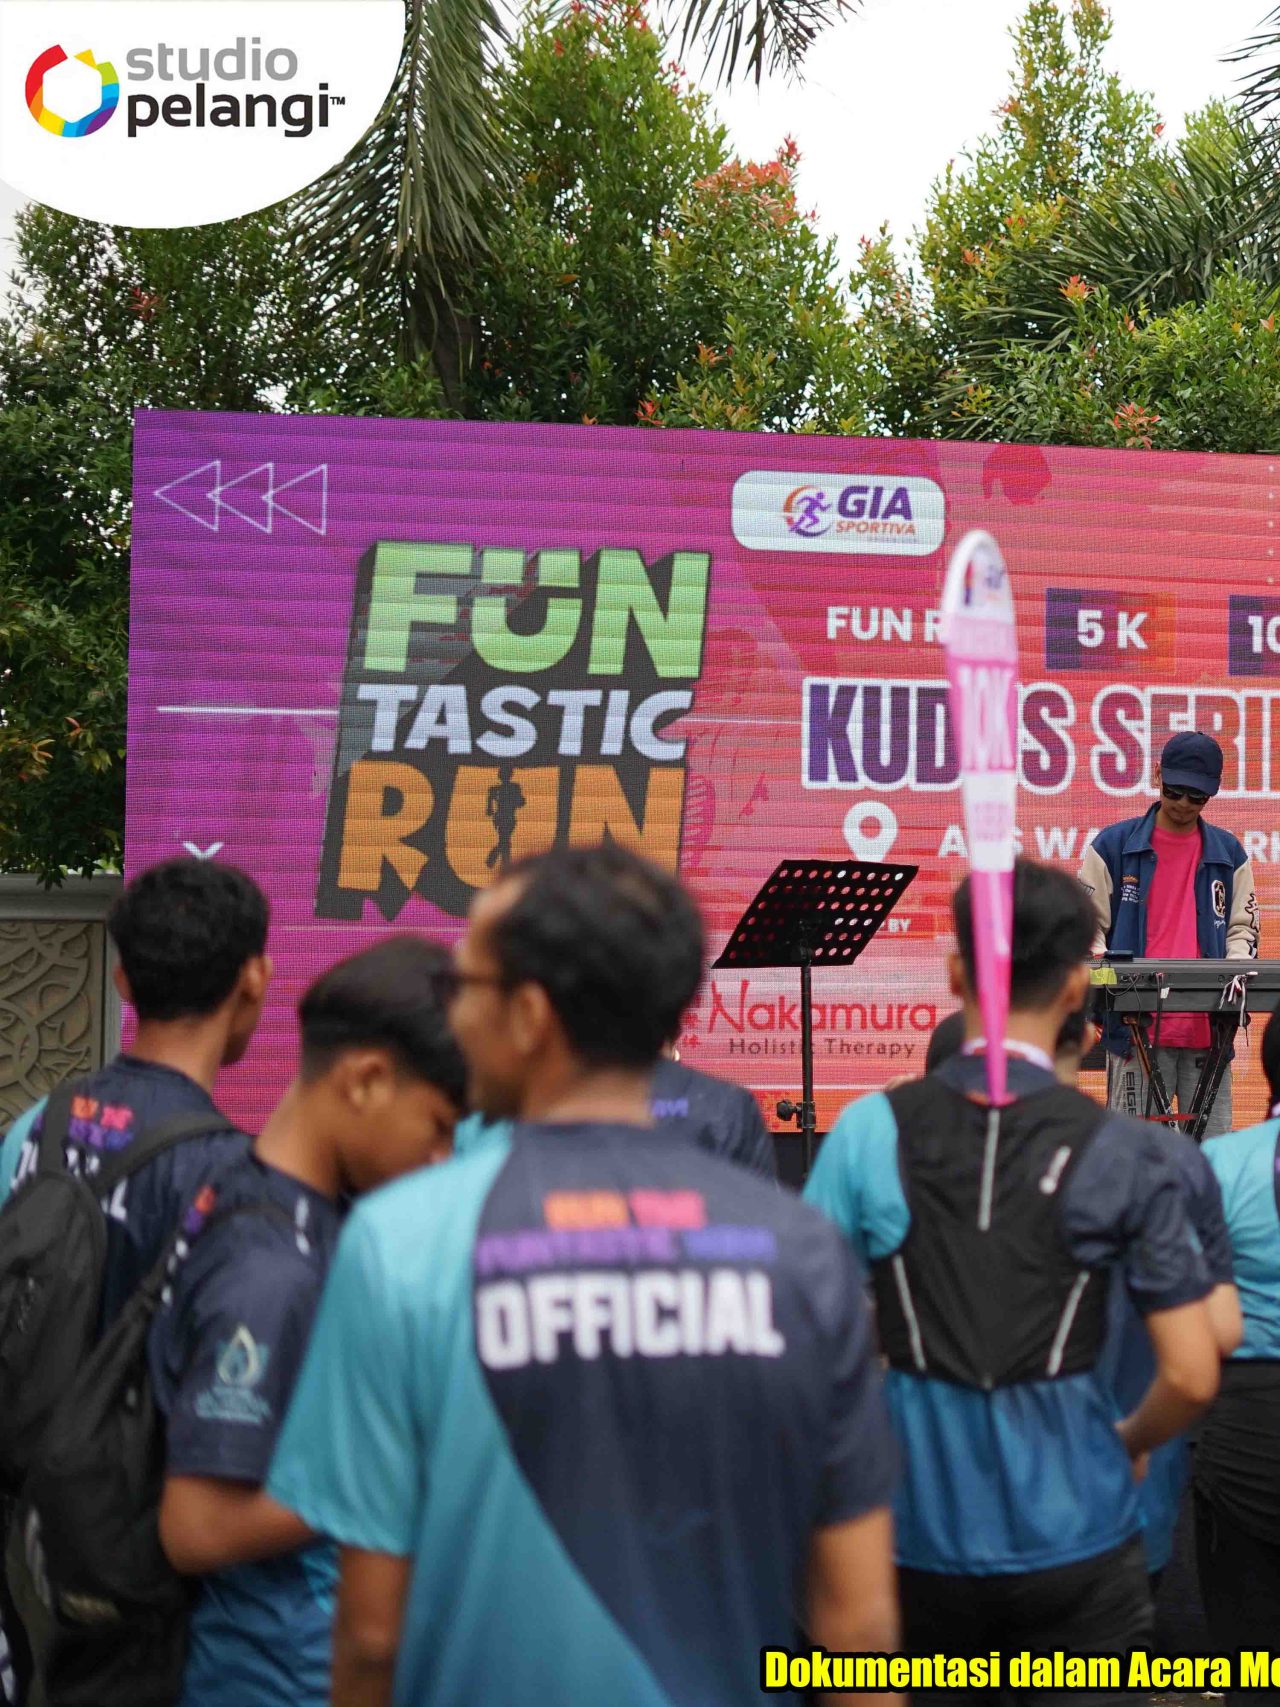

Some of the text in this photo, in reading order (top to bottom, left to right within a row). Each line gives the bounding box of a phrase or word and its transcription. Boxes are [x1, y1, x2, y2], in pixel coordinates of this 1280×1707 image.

[836, 520, 917, 534] SPORTIVA
[838, 485, 912, 520] GIA
[362, 540, 710, 679] FUN
[827, 605, 913, 642] FUN
[1076, 609, 1149, 650] 5 K
[356, 682, 695, 763] TASTIC
[802, 676, 1076, 795] KUDS
[337, 760, 686, 888] RUN
[708, 978, 938, 1034] Nakamura
[825, 1038, 916, 1059] Therapy
[477, 1268, 787, 1371] OFFICIAL
